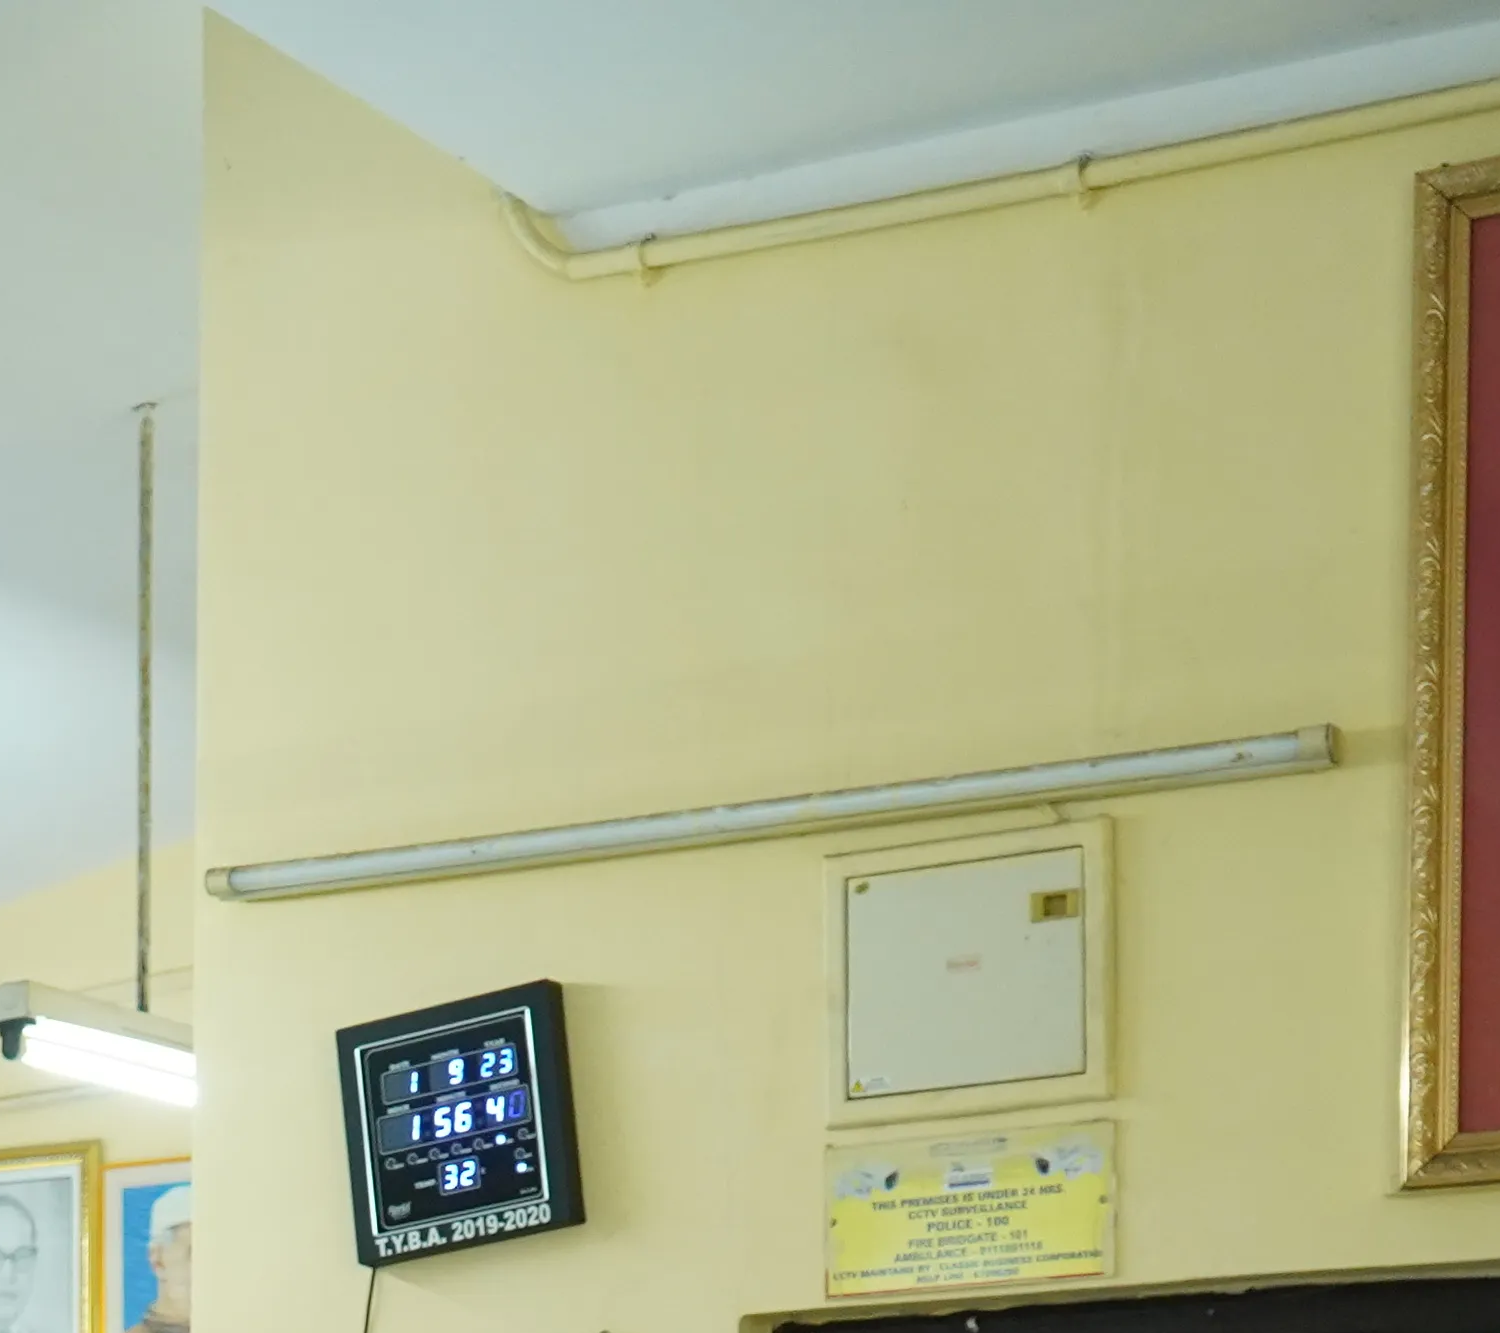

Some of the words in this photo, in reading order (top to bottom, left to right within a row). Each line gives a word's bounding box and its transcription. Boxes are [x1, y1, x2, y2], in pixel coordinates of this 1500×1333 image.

[448, 1058, 464, 1085] 9
[480, 1047, 514, 1079] 23
[433, 1100, 473, 1138] 56
[444, 1160, 477, 1191] 32
[978, 1187, 1019, 1201] UNDER
[908, 1207, 938, 1220] CCTV
[927, 1218, 973, 1232] POLICE
[986, 1216, 1010, 1229] 100
[375, 1226, 448, 1258] T.Y.B.A.
[451, 1203, 552, 1243] 2019-2020
[908, 1238, 933, 1250] FIRE
